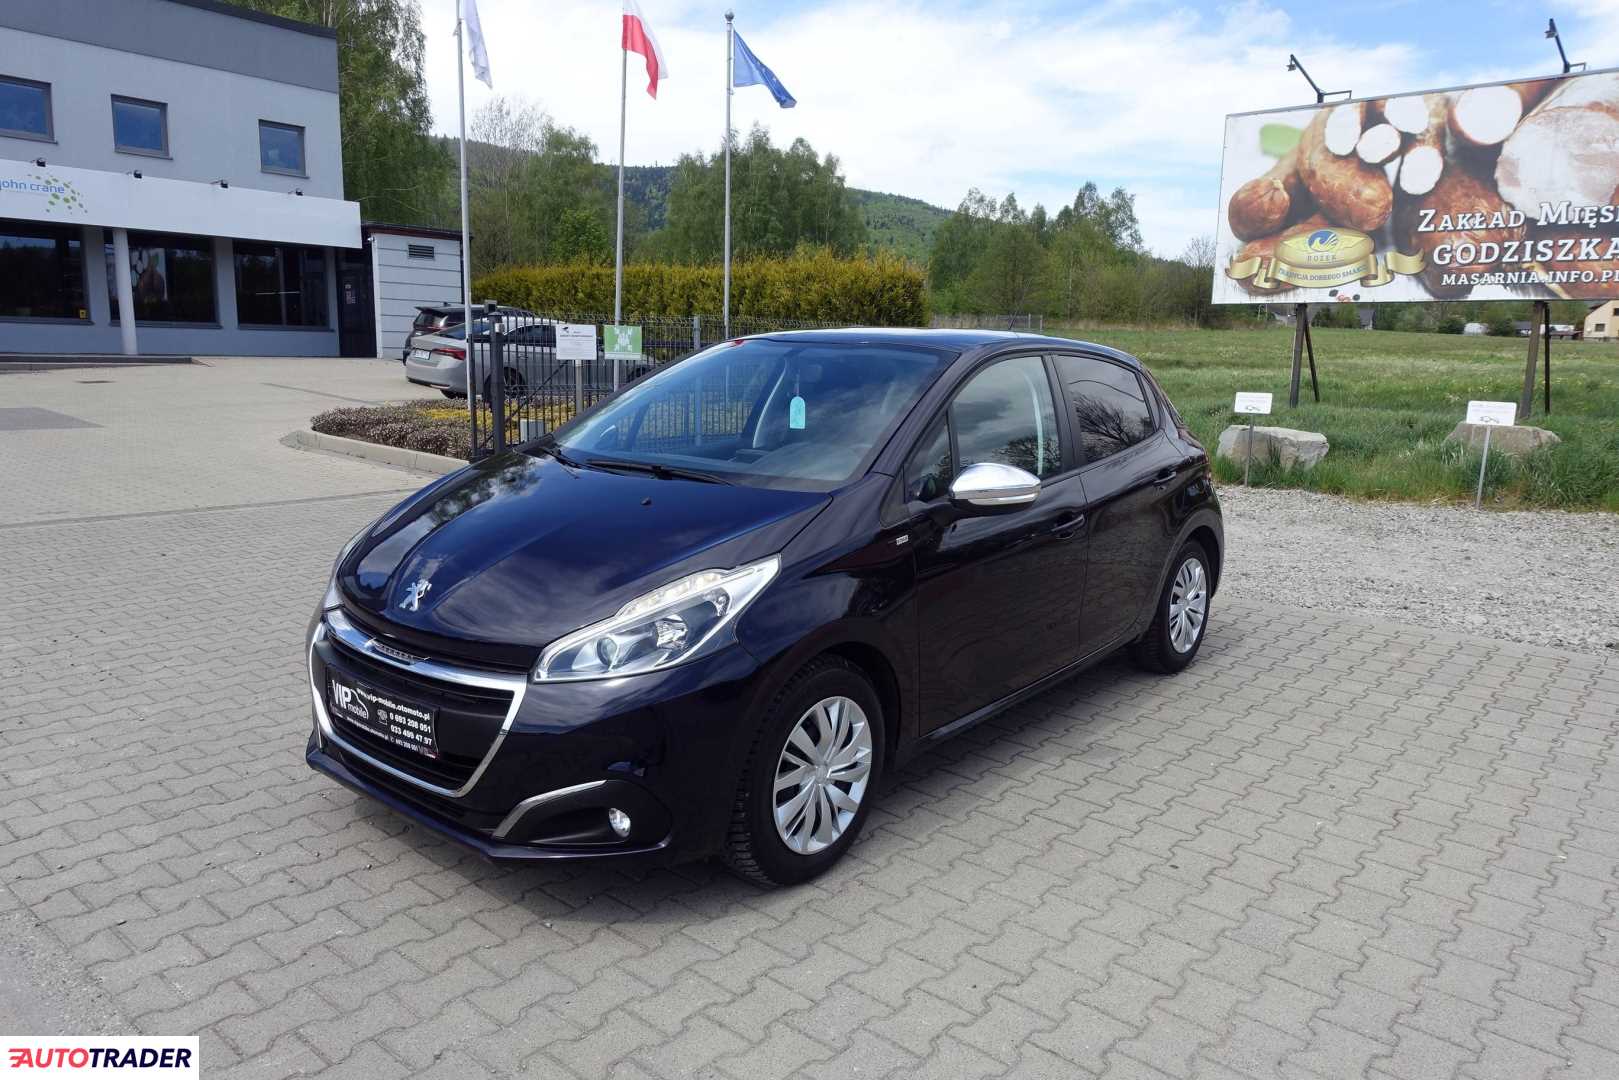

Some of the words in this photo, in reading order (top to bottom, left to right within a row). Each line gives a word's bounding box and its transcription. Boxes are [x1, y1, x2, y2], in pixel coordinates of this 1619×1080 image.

[30, 182, 65, 194] crane
[1418, 208, 1526, 232] ZAKŁAD
[1433, 236, 1619, 266] GODZISZKA
[331, 679, 352, 709] VIP
[347, 703, 368, 719] mobile
[389, 712, 394, 721] 0
